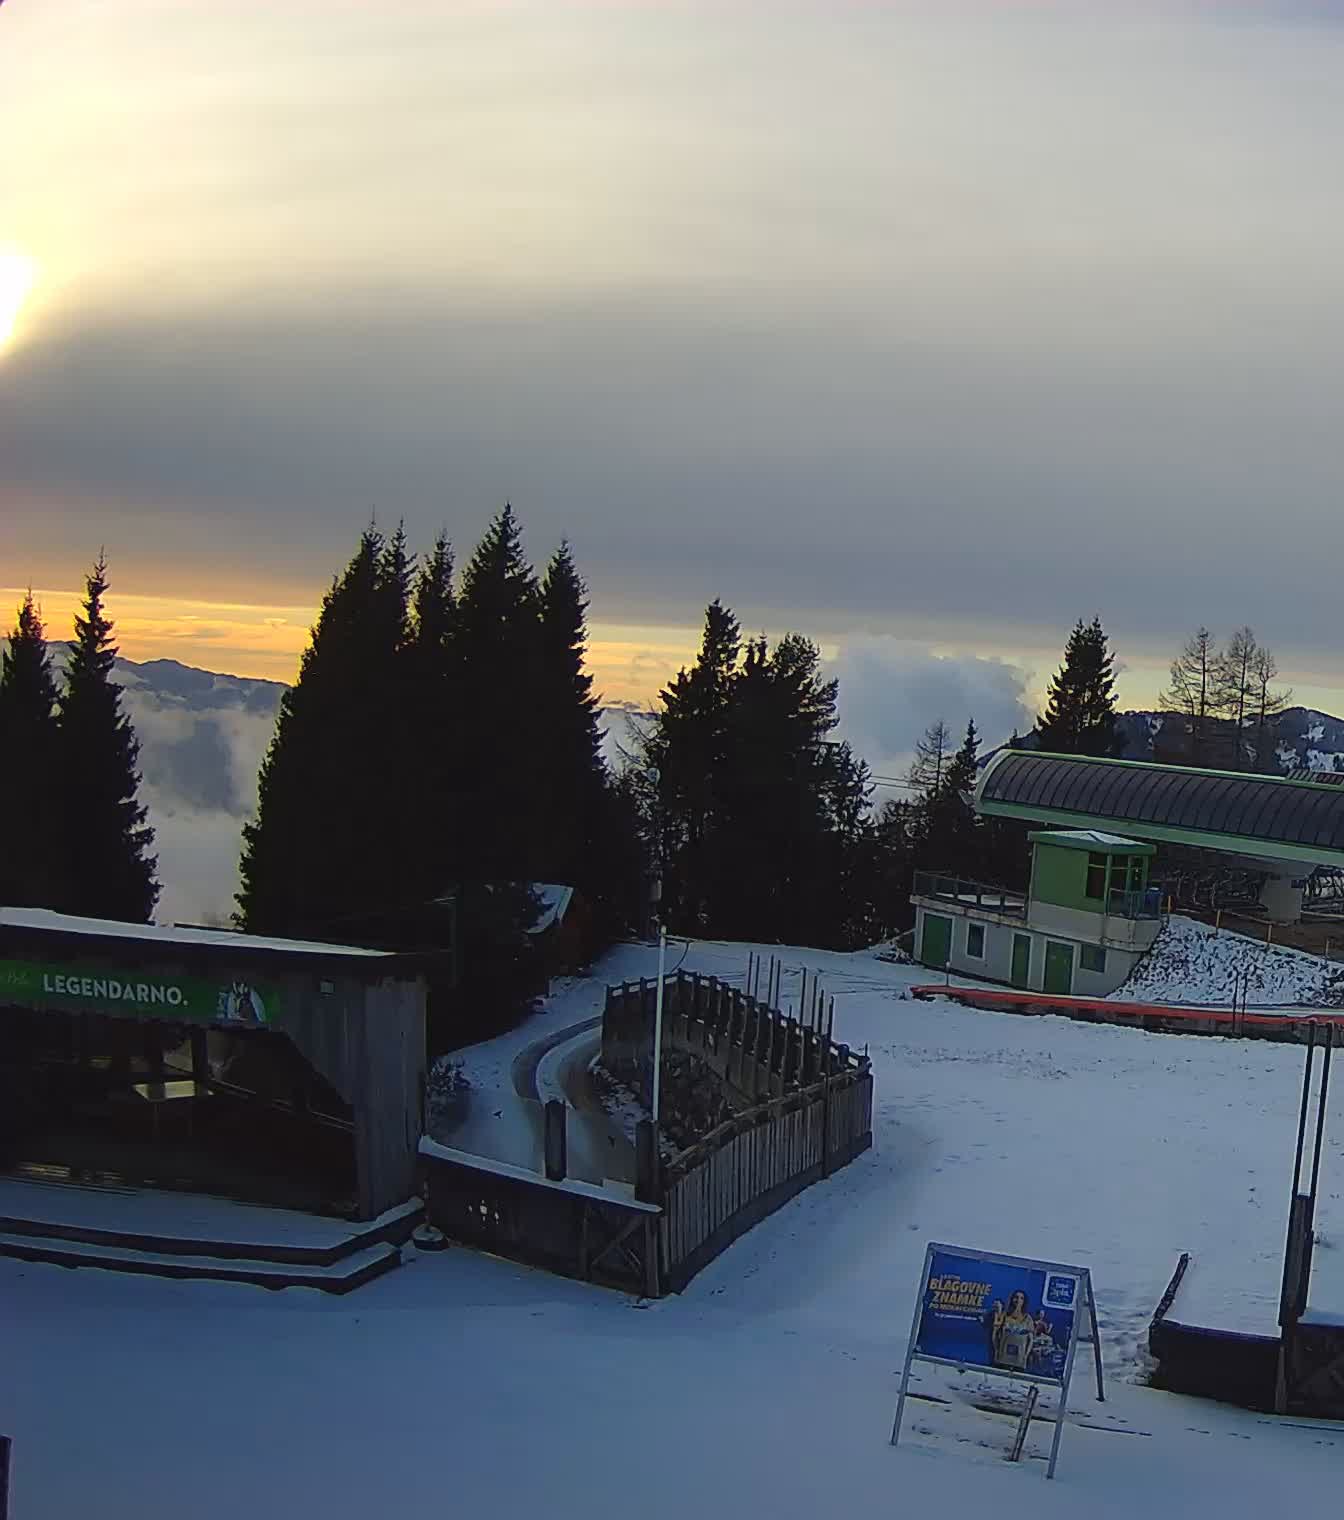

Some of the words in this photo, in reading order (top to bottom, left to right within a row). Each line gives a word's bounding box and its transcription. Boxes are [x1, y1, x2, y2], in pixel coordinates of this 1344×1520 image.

[43, 973, 189, 1007] LEGENDARNO.
[929, 1277, 992, 1297] BLAGOVNE
[931, 1290, 985, 1307] ZNAMKE
